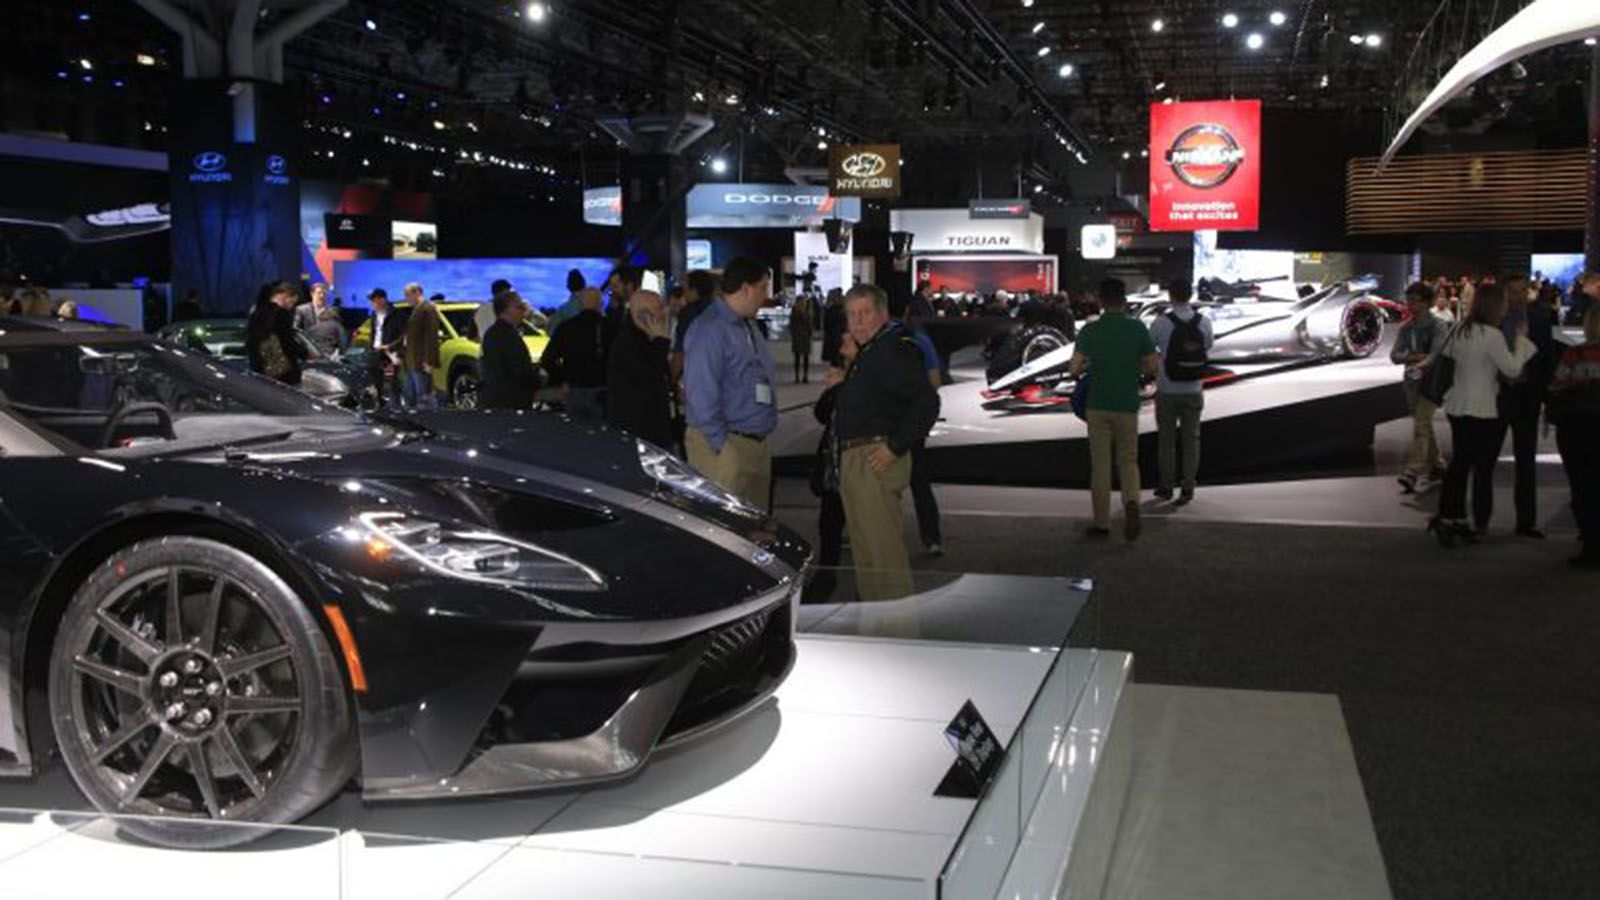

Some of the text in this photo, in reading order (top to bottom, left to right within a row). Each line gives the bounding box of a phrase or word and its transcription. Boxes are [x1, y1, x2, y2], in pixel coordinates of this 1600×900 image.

[1169, 211, 1238, 220] that excites
[947, 236, 1011, 246] TIGUAN
